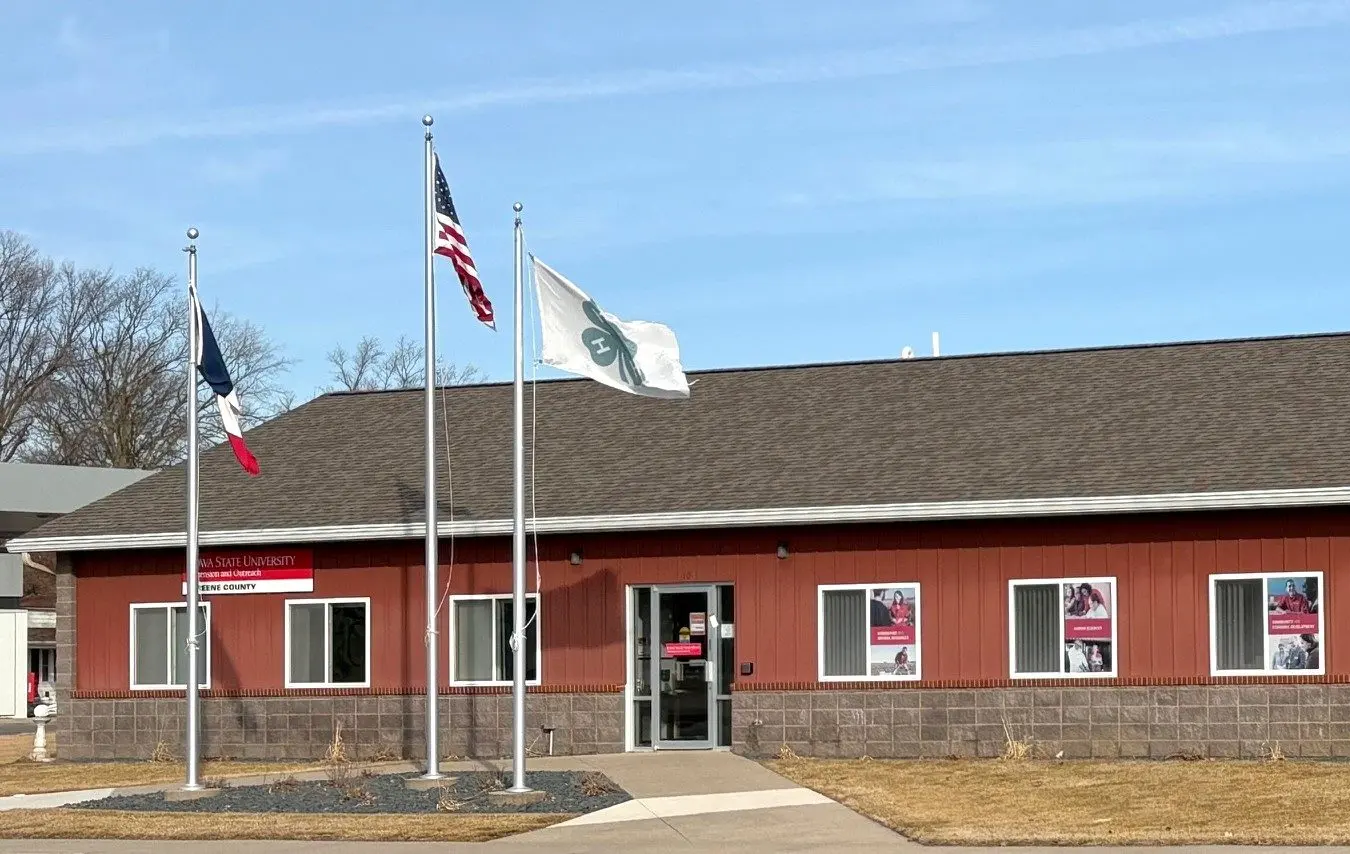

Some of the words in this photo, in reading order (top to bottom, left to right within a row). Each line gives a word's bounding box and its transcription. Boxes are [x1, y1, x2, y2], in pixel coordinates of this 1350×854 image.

[215, 556, 241, 568] STATE
[243, 555, 296, 567] UNIVERSITY
[198, 570, 220, 579] ension
[220, 569, 232, 577] and
[233, 568, 262, 577] Outreach
[199, 584, 221, 592] EENE
[223, 583, 257, 591] COUNTY
